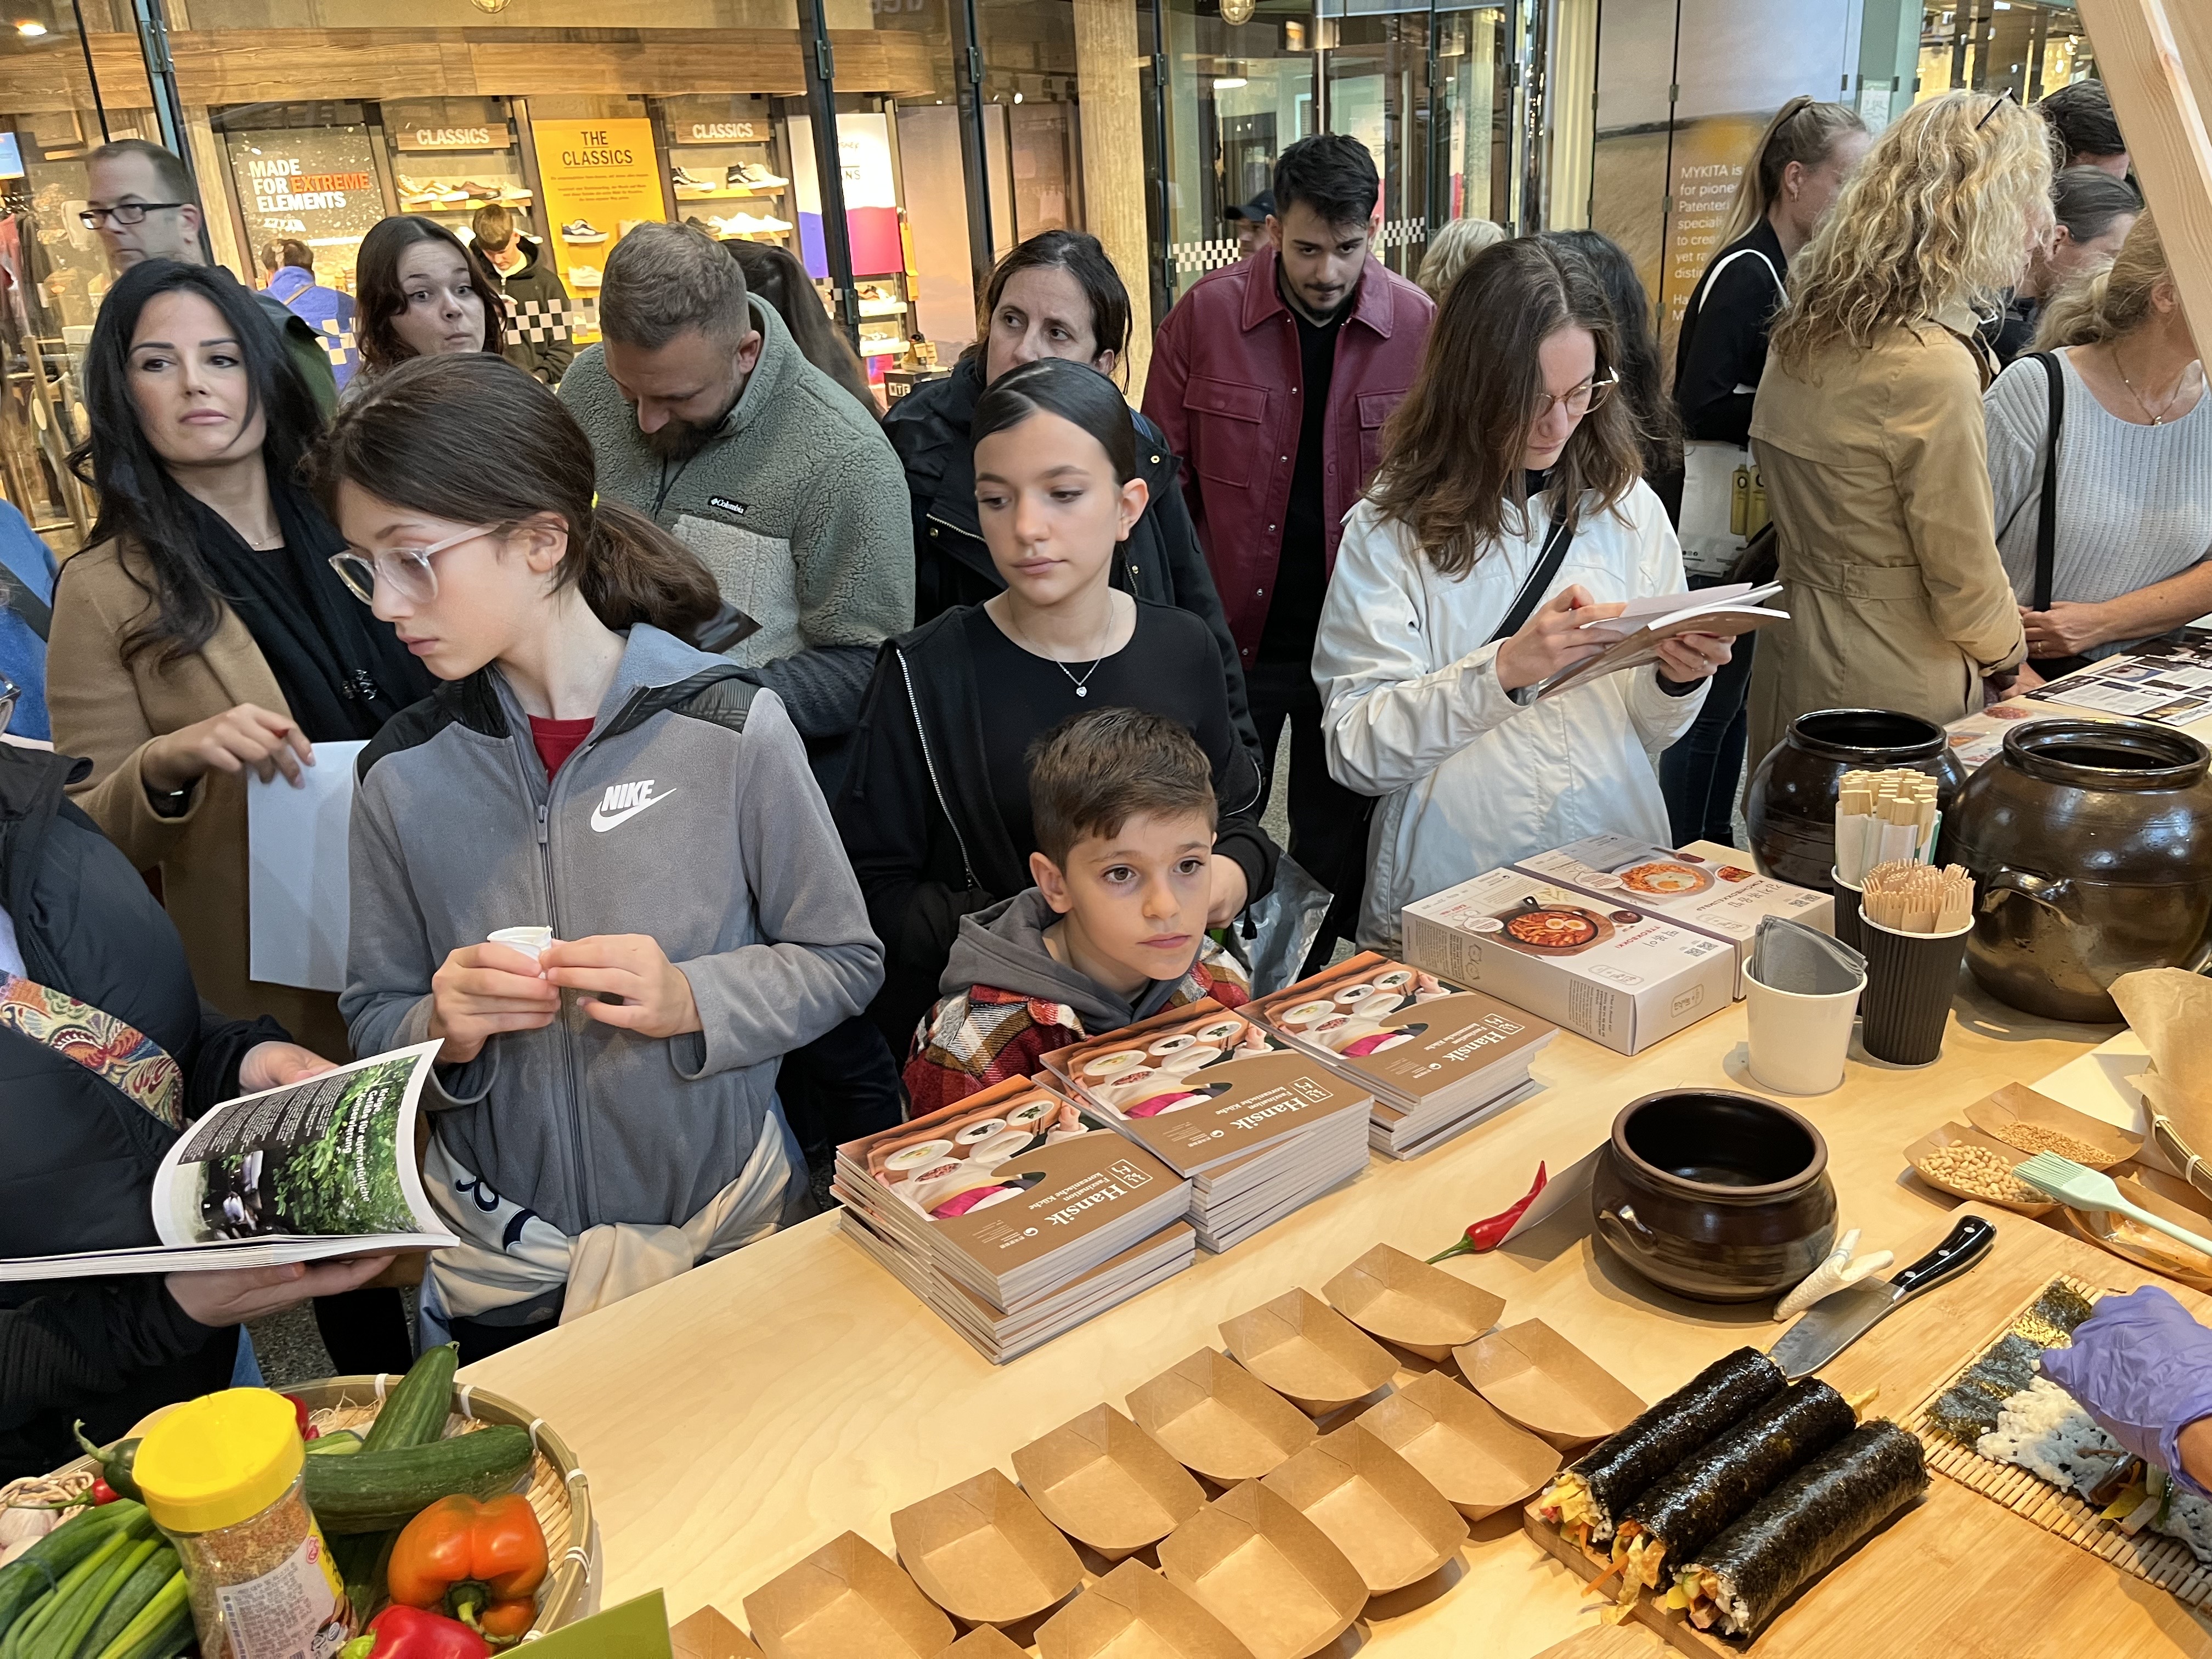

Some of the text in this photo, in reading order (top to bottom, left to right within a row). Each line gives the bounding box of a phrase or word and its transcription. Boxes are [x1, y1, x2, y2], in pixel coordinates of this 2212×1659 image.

[416, 128, 490, 145] CLASSICS
[580, 131, 608, 145] THE
[692, 123, 754, 139] CLASSICS
[249, 159, 302, 177] MADE
[562, 150, 633, 166] CLASSICS
[842, 170, 861, 180] NS
[1681, 165, 1728, 179] MYKITA
[252, 172, 371, 195] FOR EXTREME
[1680, 182, 1738, 197] for pione
[256, 191, 347, 212] ELEMENTS
[1677, 236, 1688, 246] to
[1675, 253, 1693, 264] yet
[601, 780, 654, 811] NIKE
[1442, 1031, 1506, 1062] Hansik
[360, 1090, 378, 1119] Gefäße
[1215, 1086, 1286, 1115] koreanische Küche
[1247, 1090, 1293, 1110] Faszination
[342, 1092, 367, 1154] Konservierung
[1229, 1096, 1309, 1130] Hansik
[358, 1120, 369, 1134] für
[357, 1156, 370, 1202] natürliche
[1028, 1172, 1104, 1210] koreanische Küche
[1063, 1177, 1110, 1202] Faszination
[1044, 1183, 1127, 1226] Hansik
